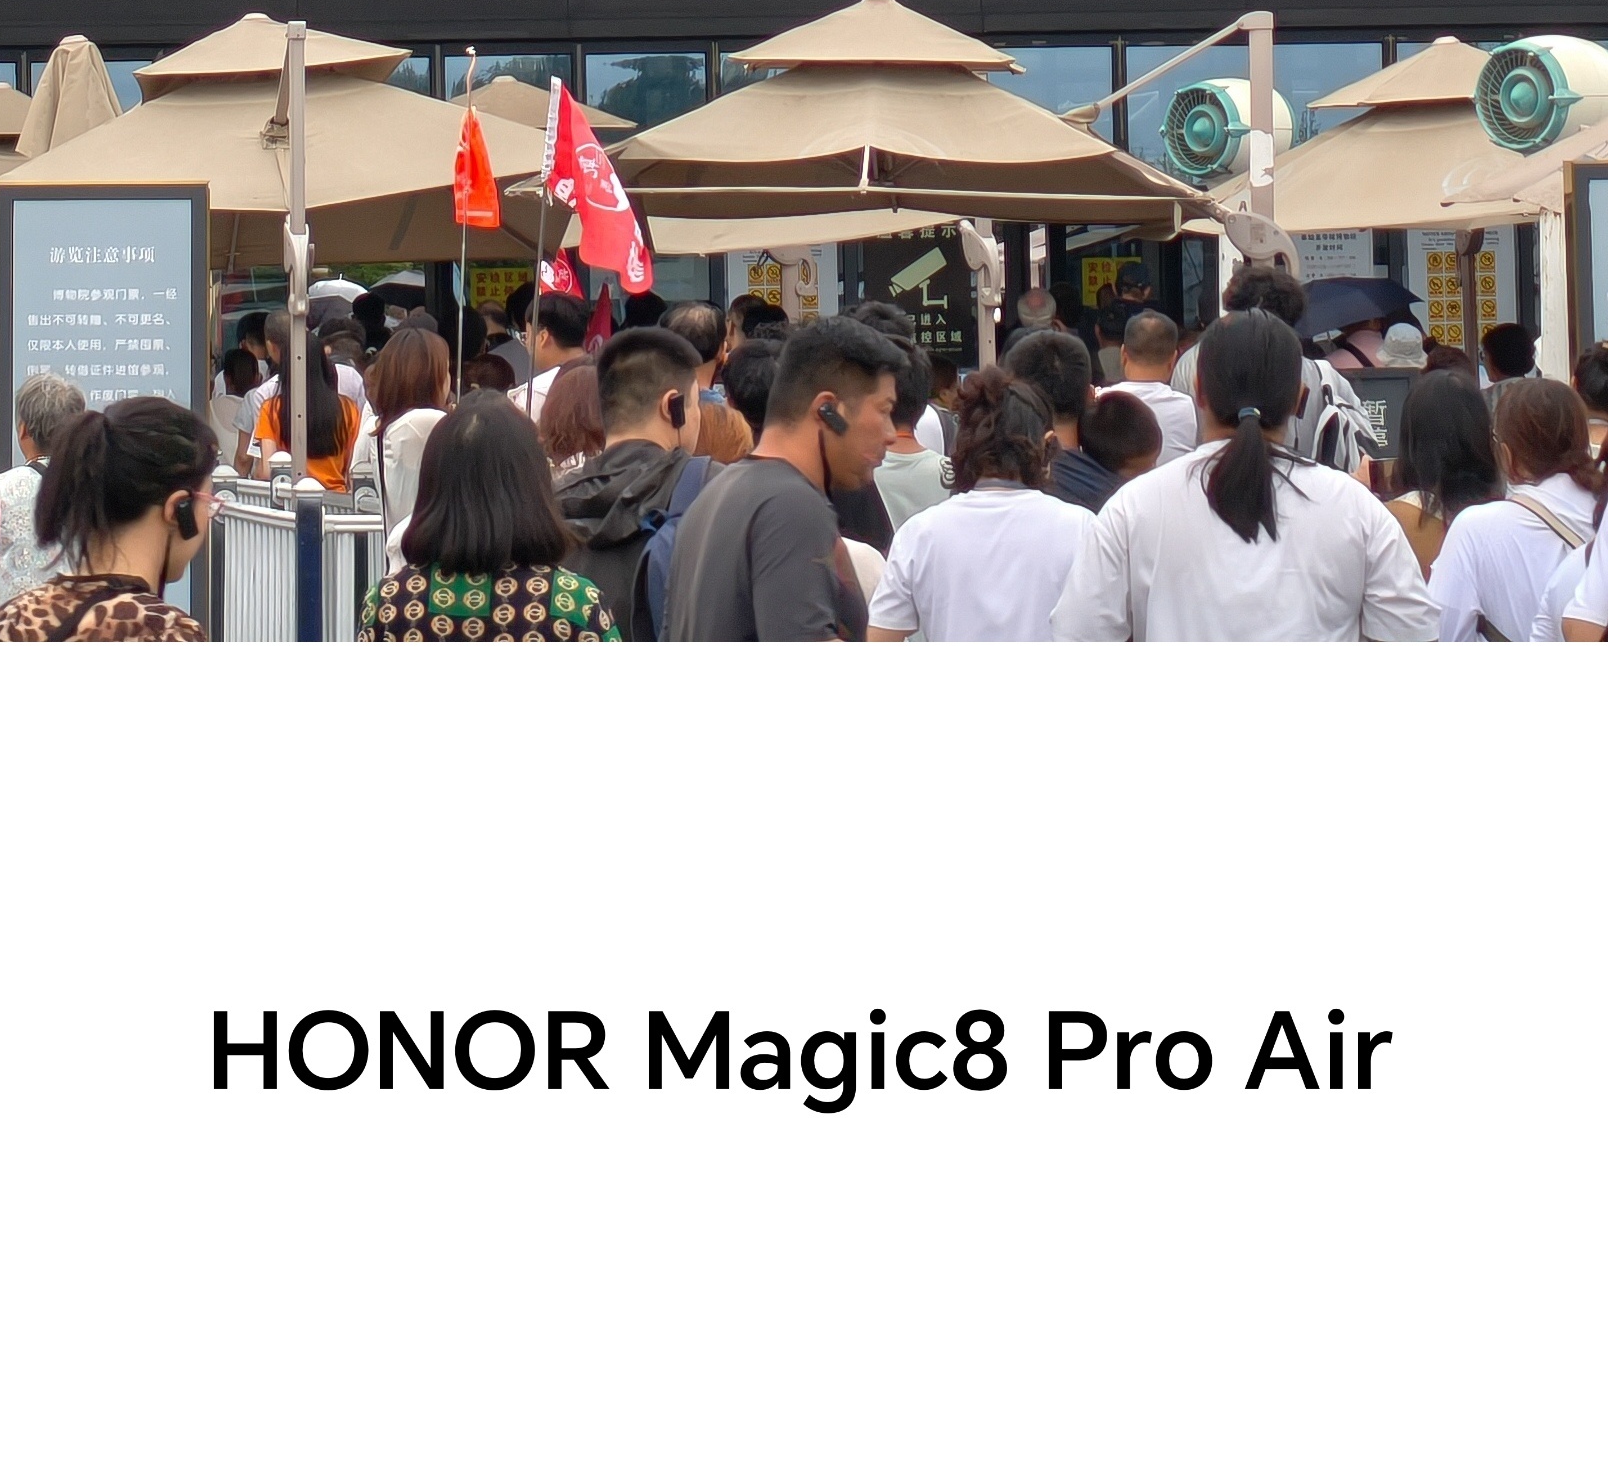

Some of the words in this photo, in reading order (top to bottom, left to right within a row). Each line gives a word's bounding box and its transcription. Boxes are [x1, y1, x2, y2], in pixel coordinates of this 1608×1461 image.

[49, 246, 156, 263] 游览注意事项
